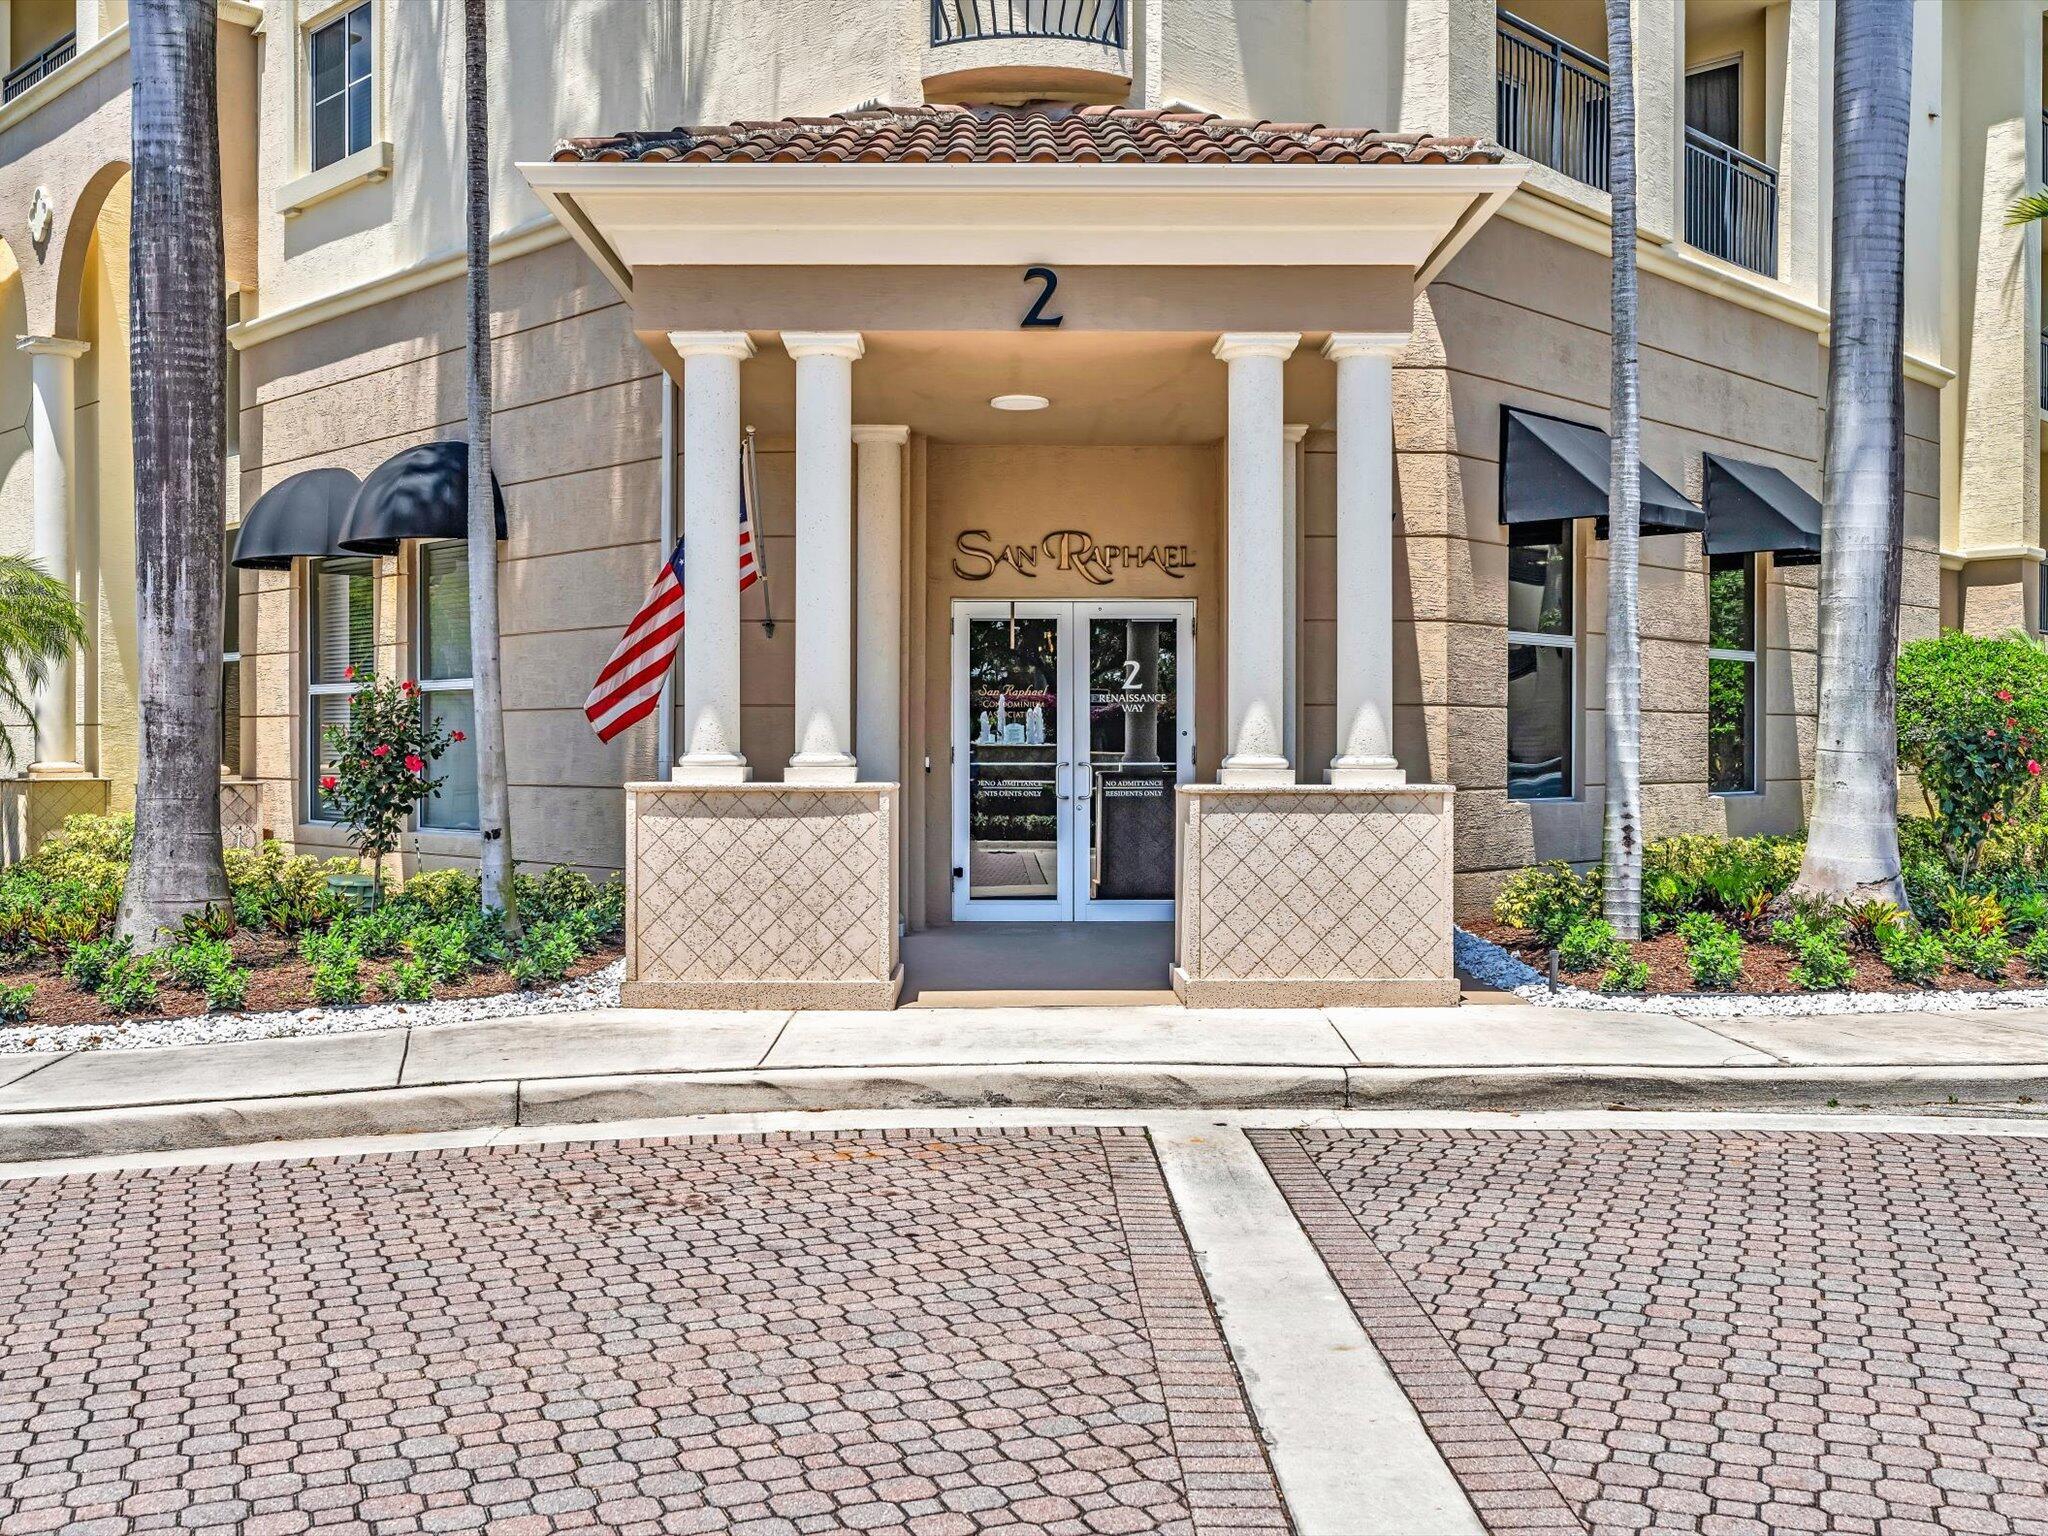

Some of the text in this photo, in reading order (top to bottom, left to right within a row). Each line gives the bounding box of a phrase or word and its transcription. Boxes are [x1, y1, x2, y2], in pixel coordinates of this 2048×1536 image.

[1020, 267, 1064, 328] 2
[953, 529, 1197, 585] SAN RAPHAEL
[1121, 660, 1143, 690] 2
[978, 684, 1050, 699] San Raphael
[1099, 693, 1167, 703] RENAISSANCE
[1121, 703, 1145, 713] WAY
[1022, 790, 1043, 798] ONLY
